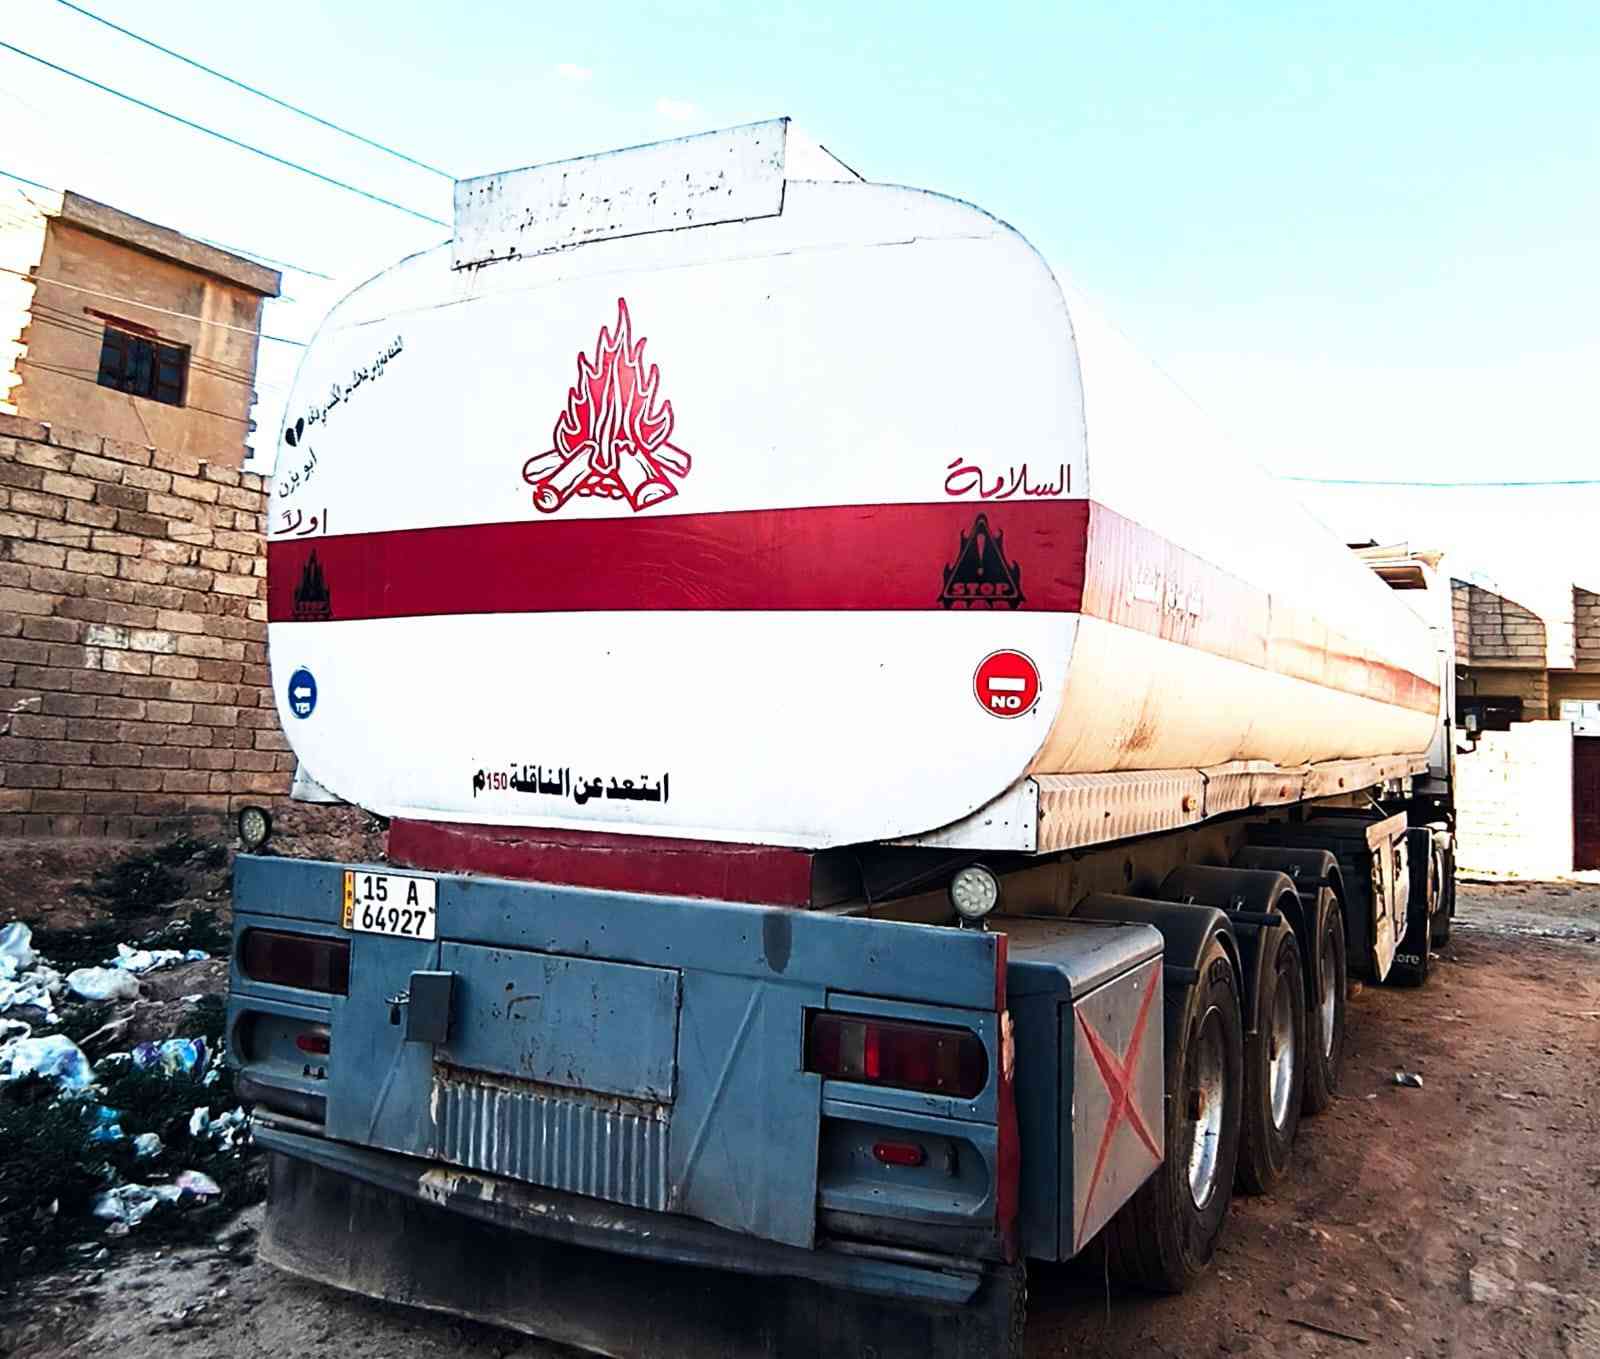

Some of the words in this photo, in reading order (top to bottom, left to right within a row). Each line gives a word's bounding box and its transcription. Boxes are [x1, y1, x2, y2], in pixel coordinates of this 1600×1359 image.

[943, 456, 1071, 499] السلامة
[951, 582, 1011, 596] STOP
[990, 695, 1022, 709] NO
[509, 763, 570, 798] الناقلة
[573, 776, 604, 805] عن
[363, 875, 388, 902] 15
[406, 880, 419, 906] A
[362, 904, 427, 936] 64927
